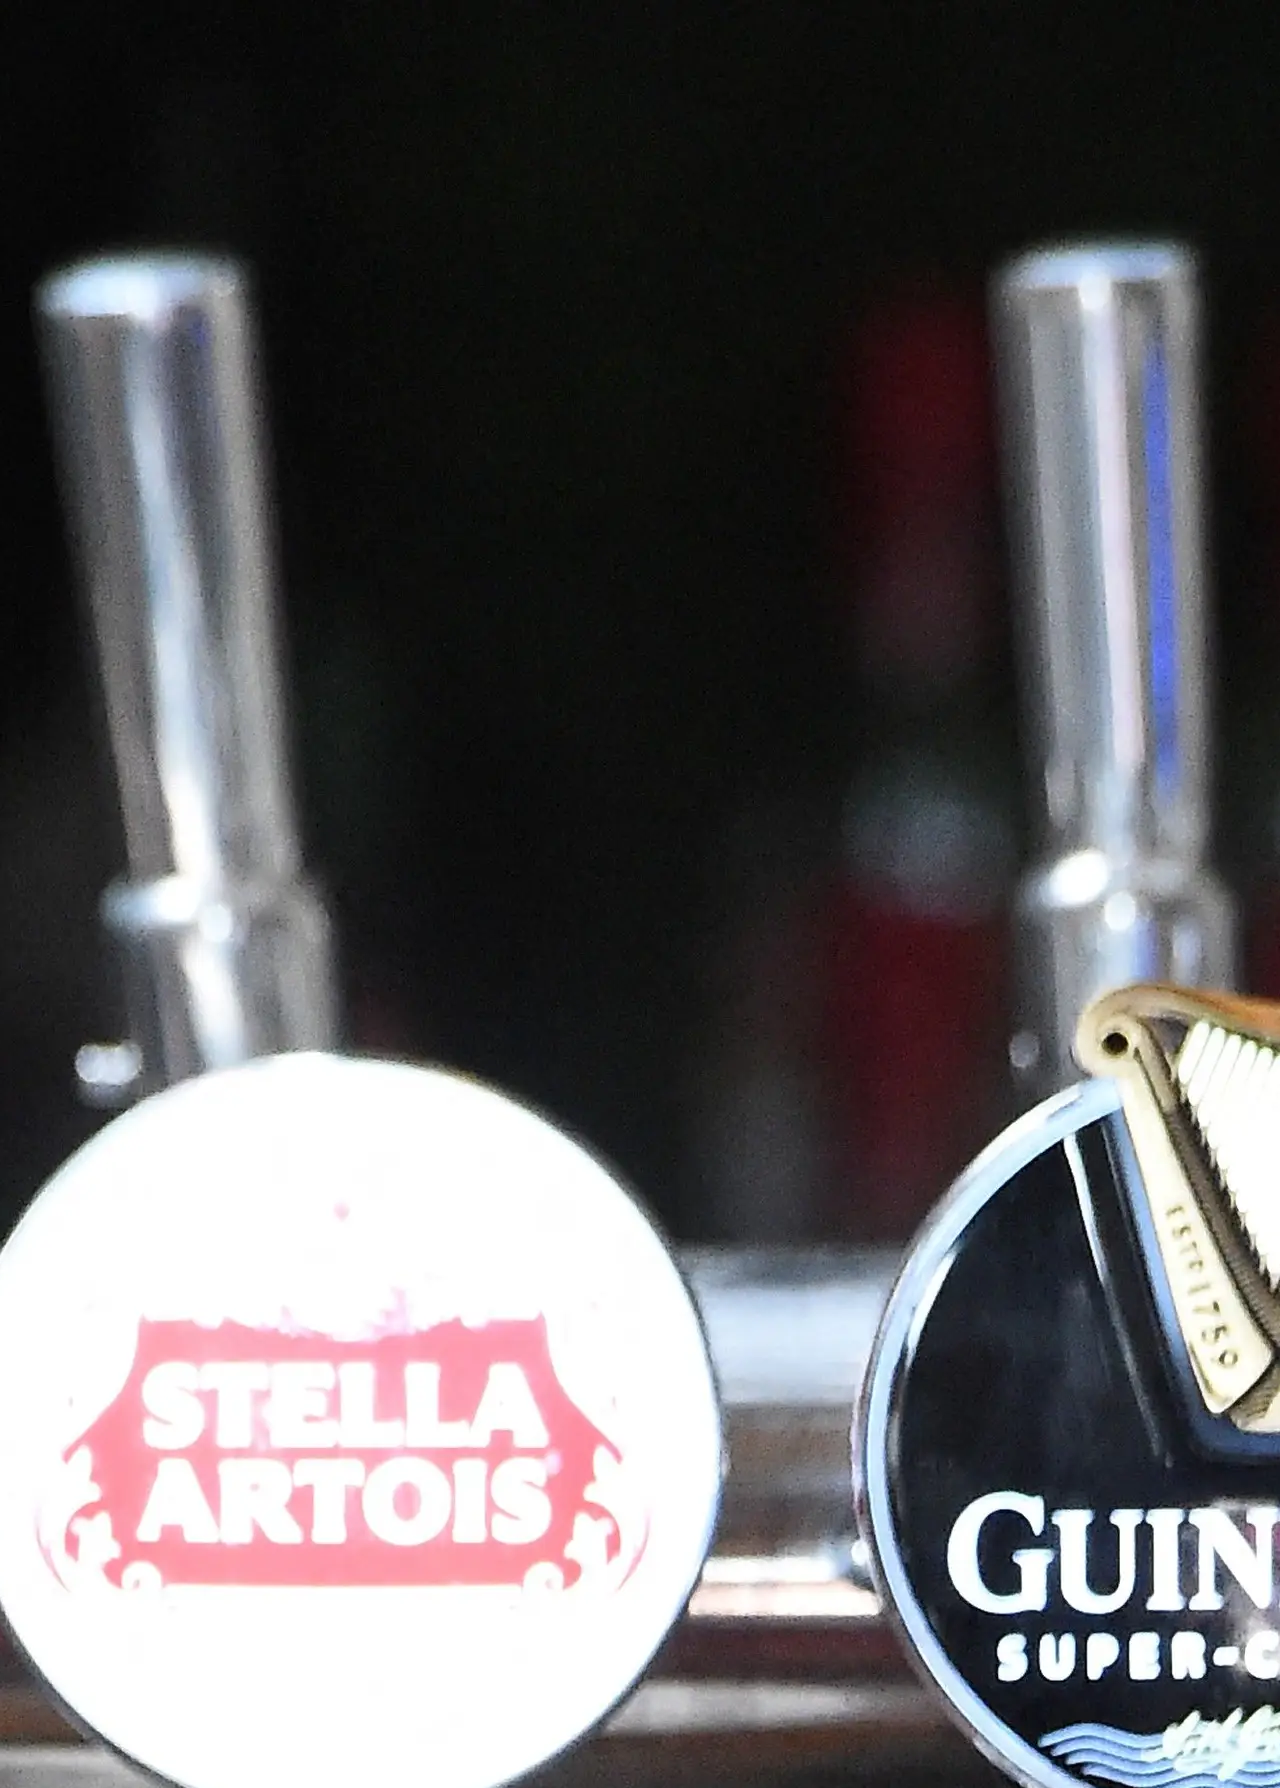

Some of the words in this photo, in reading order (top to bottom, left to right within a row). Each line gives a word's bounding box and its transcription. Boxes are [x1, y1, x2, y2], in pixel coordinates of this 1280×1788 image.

[1188, 1282, 1239, 1368] 1759
[142, 1362, 549, 1449] STELLA
[136, 1457, 553, 1547] ARTOIS
